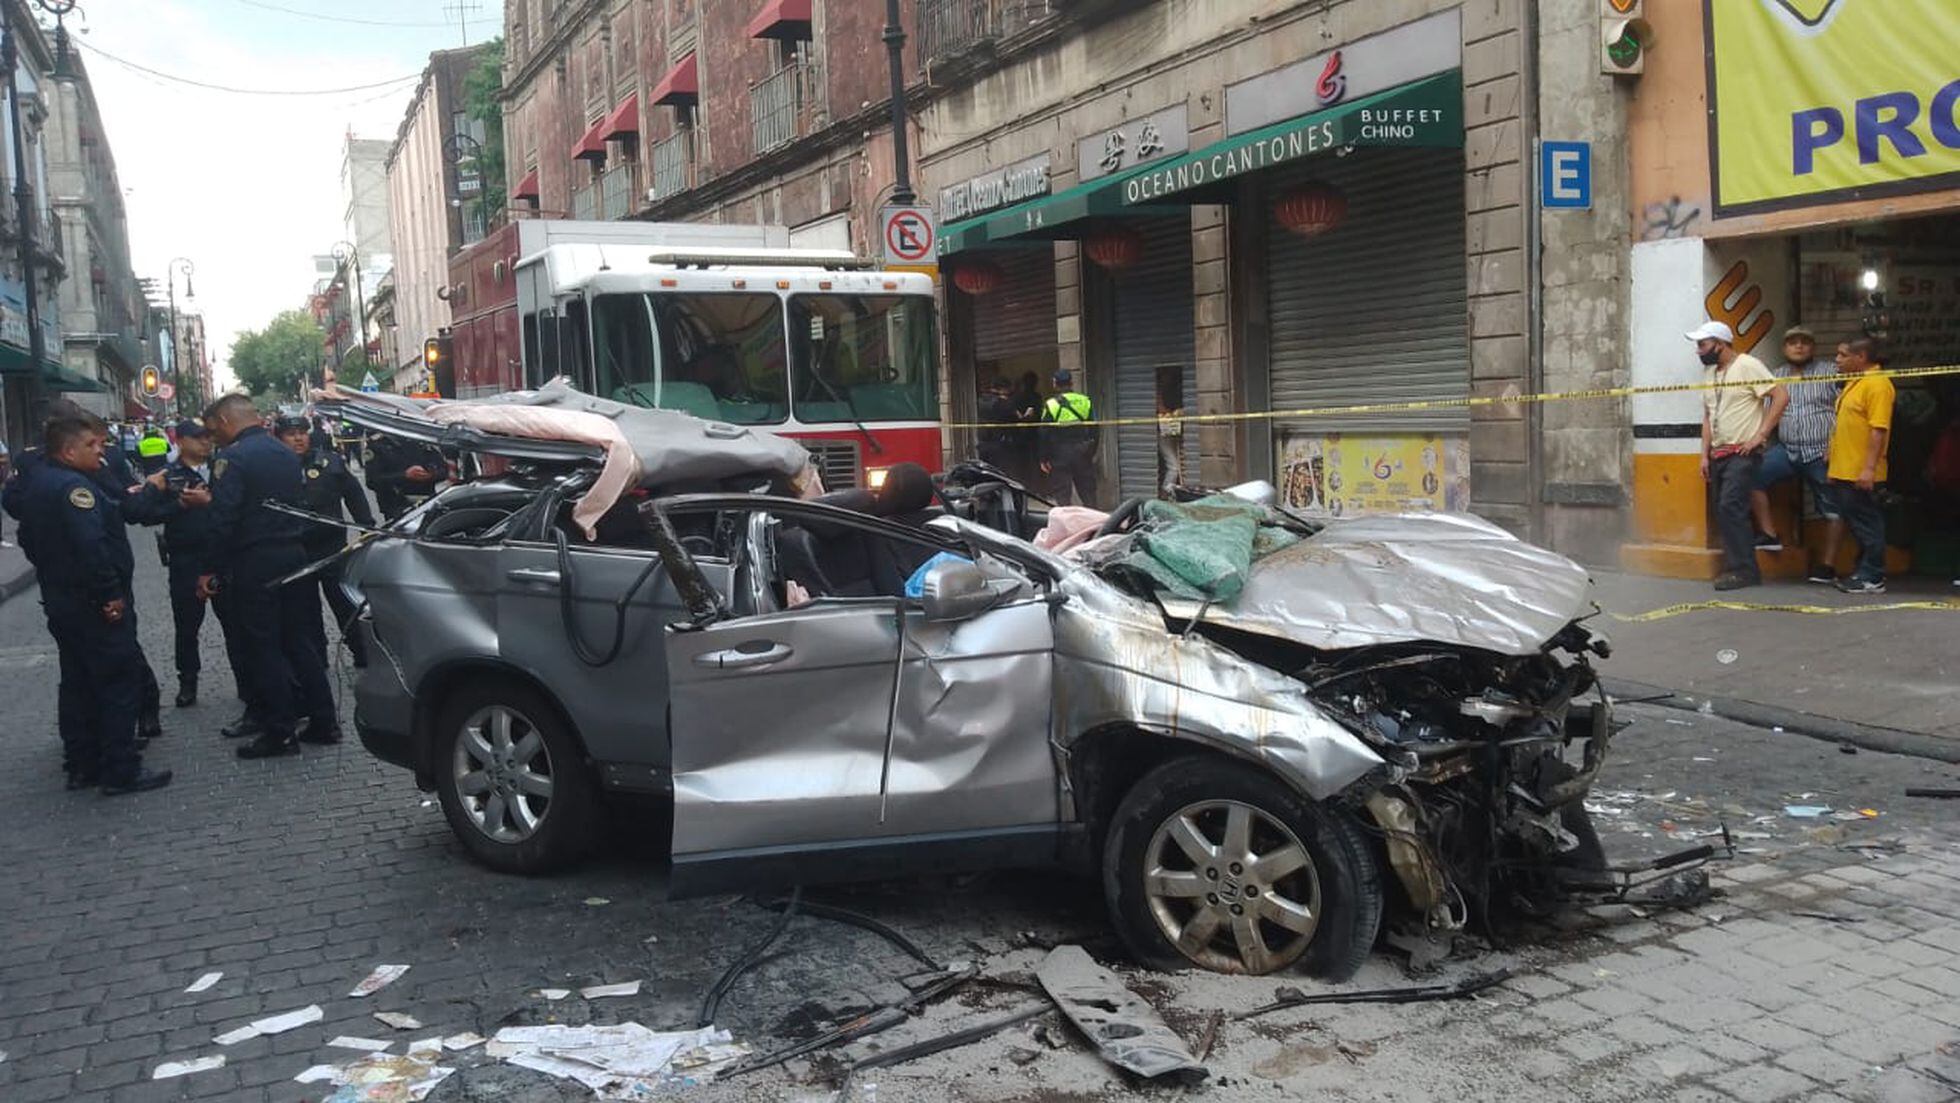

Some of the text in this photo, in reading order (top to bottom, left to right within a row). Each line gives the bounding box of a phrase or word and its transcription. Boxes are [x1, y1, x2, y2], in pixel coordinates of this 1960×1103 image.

[1361, 109, 1442, 123] BUFFET
[1361, 125, 1415, 138] CHINO
[1127, 121, 1334, 202] OCEANO CANTONES
[1552, 151, 1581, 198] E
[899, 220, 922, 250] E
